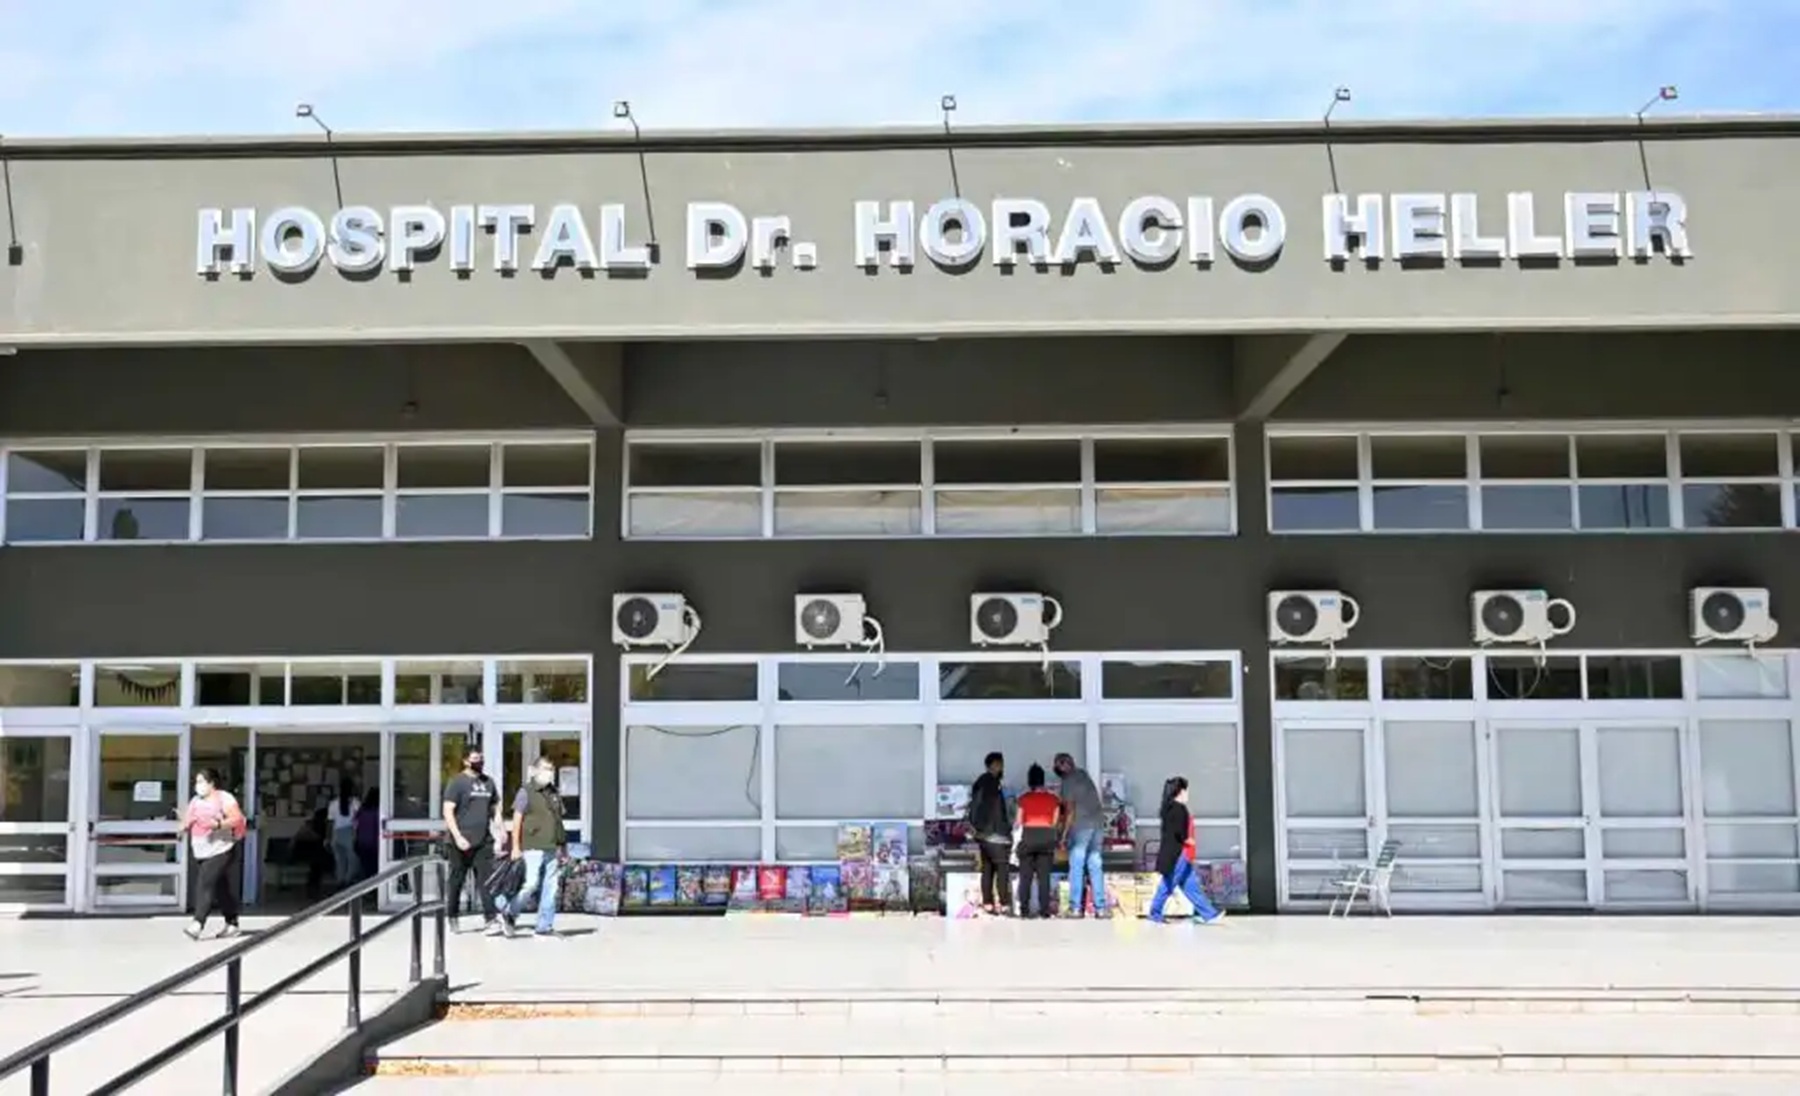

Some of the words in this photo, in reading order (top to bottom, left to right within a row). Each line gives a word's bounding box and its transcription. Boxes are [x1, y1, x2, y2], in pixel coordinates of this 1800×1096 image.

[198, 203, 650, 274] HOSPITAL
[686, 202, 816, 270] Dr.
[855, 195, 1287, 267] HORACIO
[1322, 191, 1693, 262] HELLER
